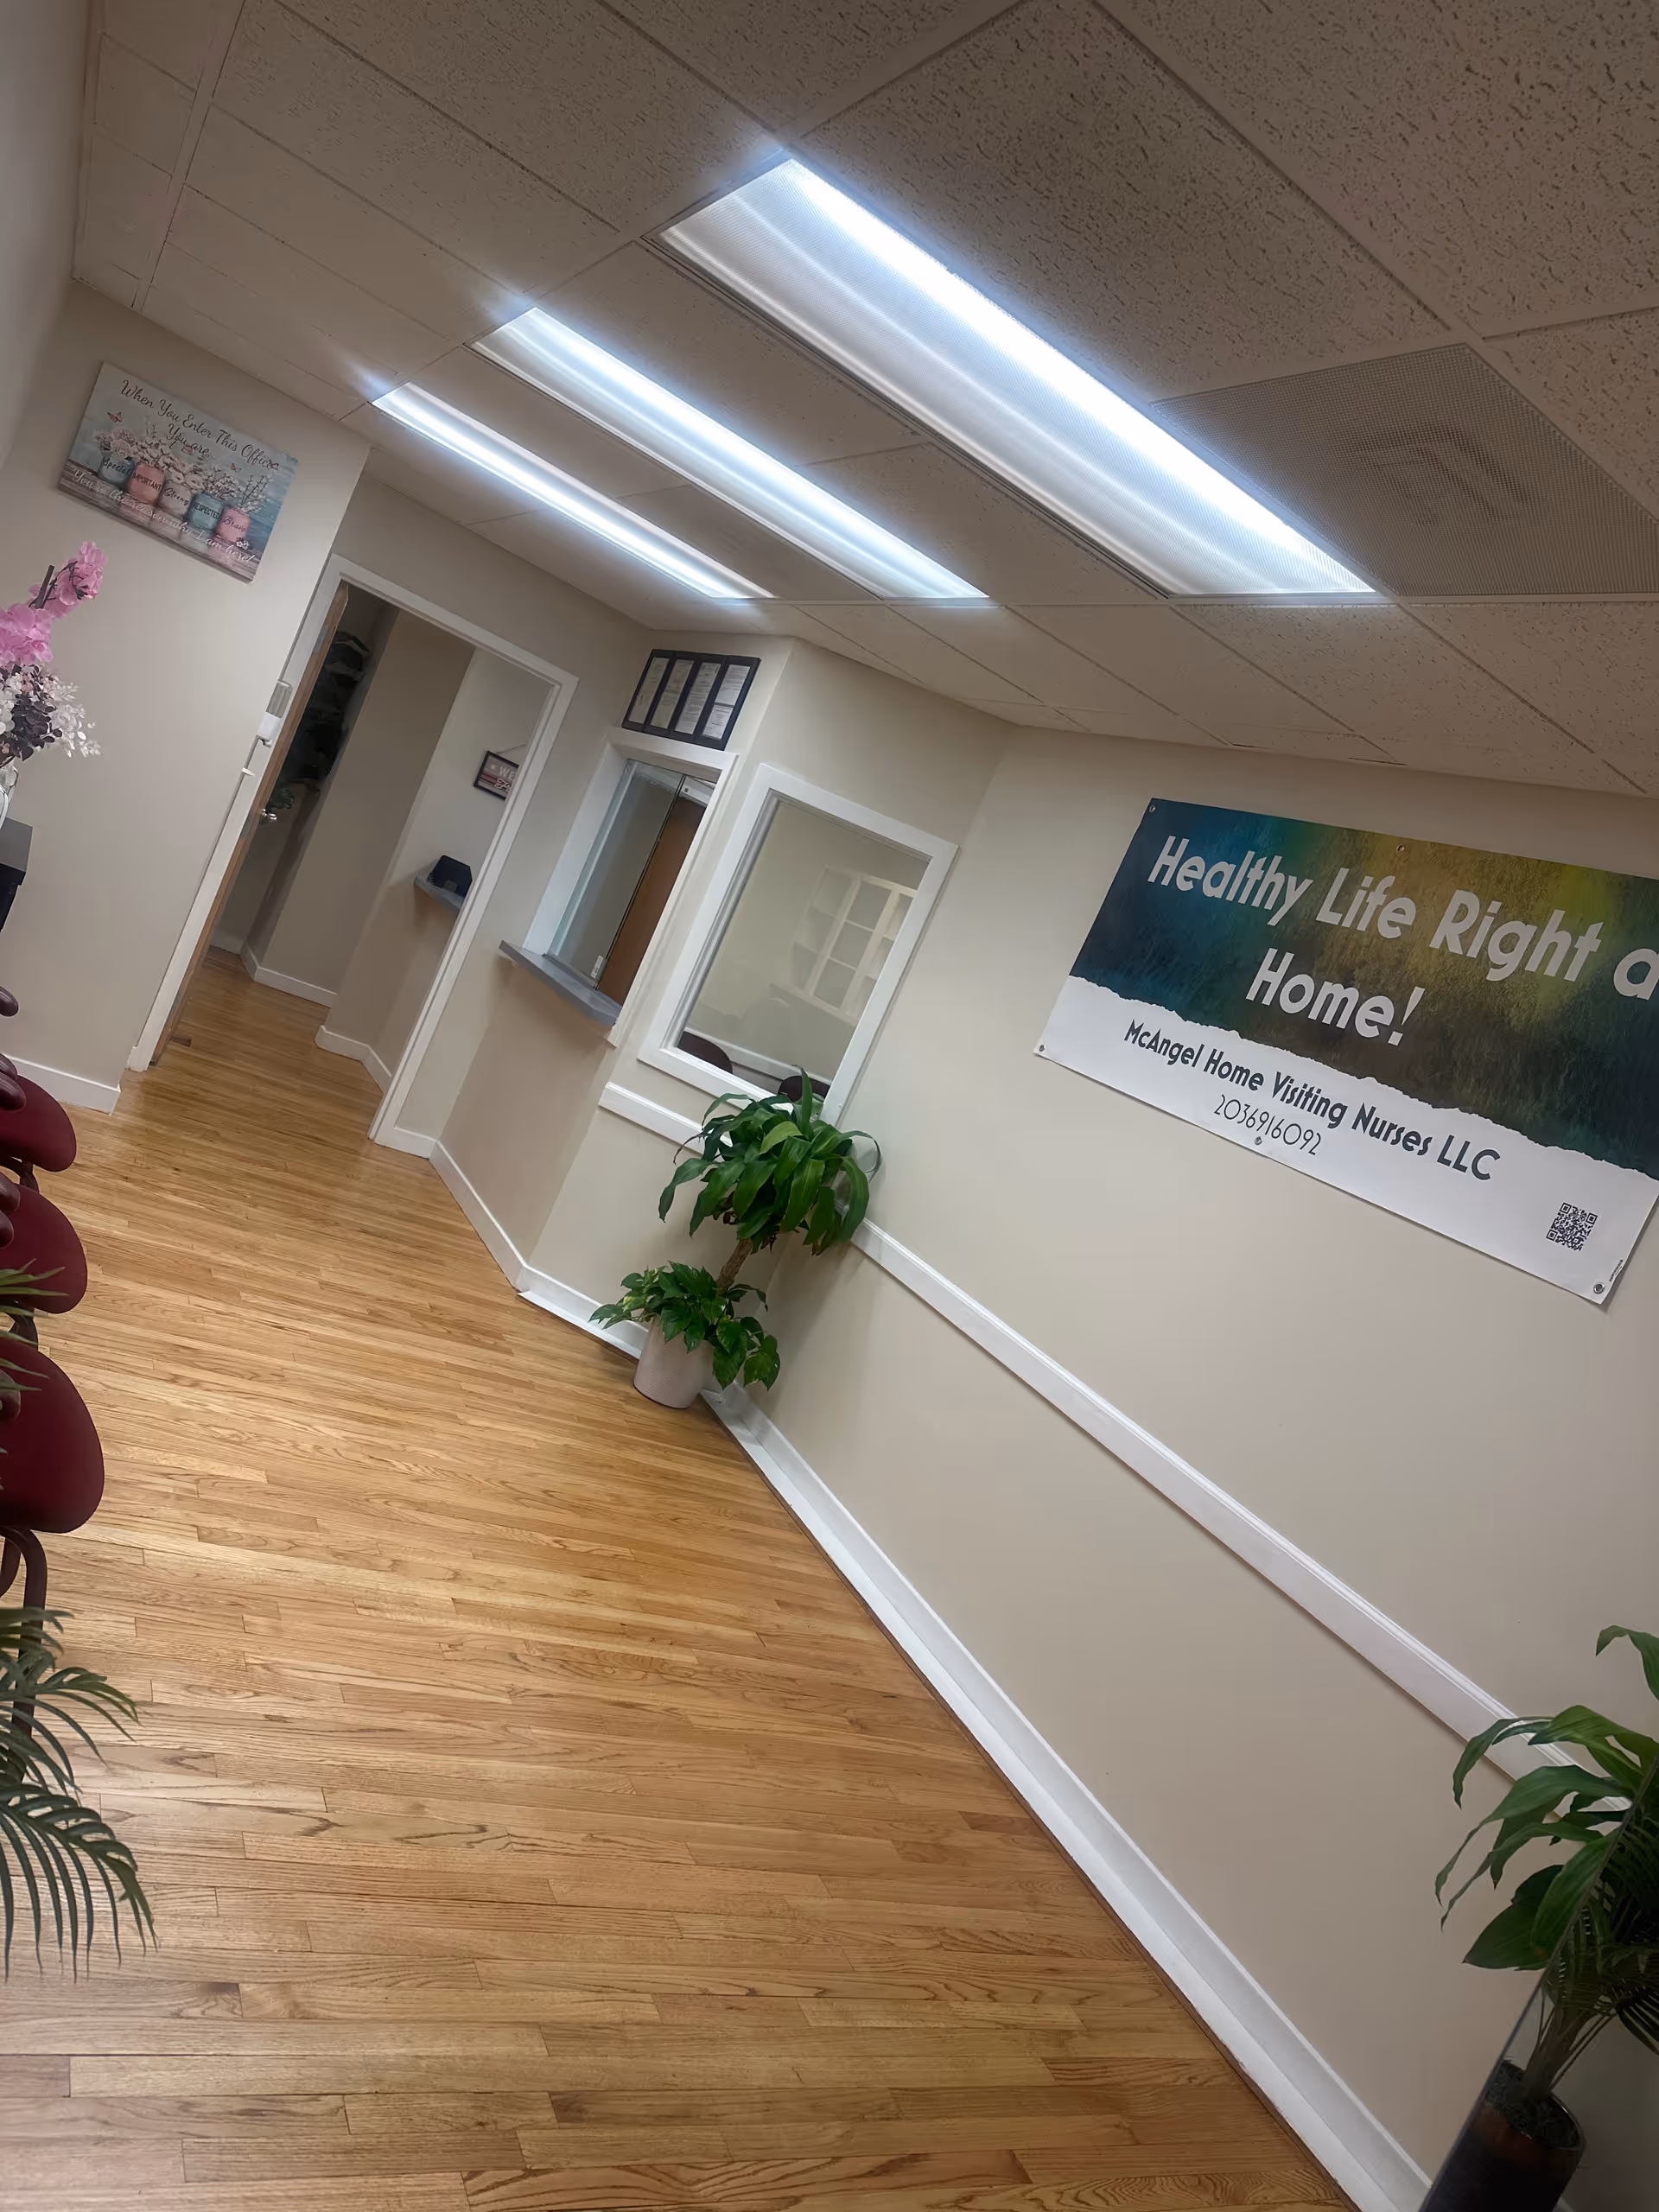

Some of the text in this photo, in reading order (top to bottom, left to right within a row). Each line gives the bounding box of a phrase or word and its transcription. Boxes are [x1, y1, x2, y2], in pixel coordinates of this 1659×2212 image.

[121, 380, 154, 408] When
[158, 399, 181, 422] You
[182, 414, 212, 438] Enter
[215, 429, 237, 452] This
[166, 423, 188, 446] You
[103, 457, 130, 476] Special
[133, 473, 162, 492] IMPORTANT
[162, 483, 190, 507] Strong
[192, 501, 220, 520] RESPECTED
[169, 522, 194, 537] why
[223, 514, 247, 533] Brave
[1147, 835, 1313, 926] Healthy
[1315, 867, 1416, 939] Life
[1430, 889, 1604, 983] Right
[1245, 948, 1425, 1046] Home!
[1123, 1019, 1501, 1180] McAngel Home Visiting Nurses LLC
[1214, 1094, 1321, 1156] 2036916092
